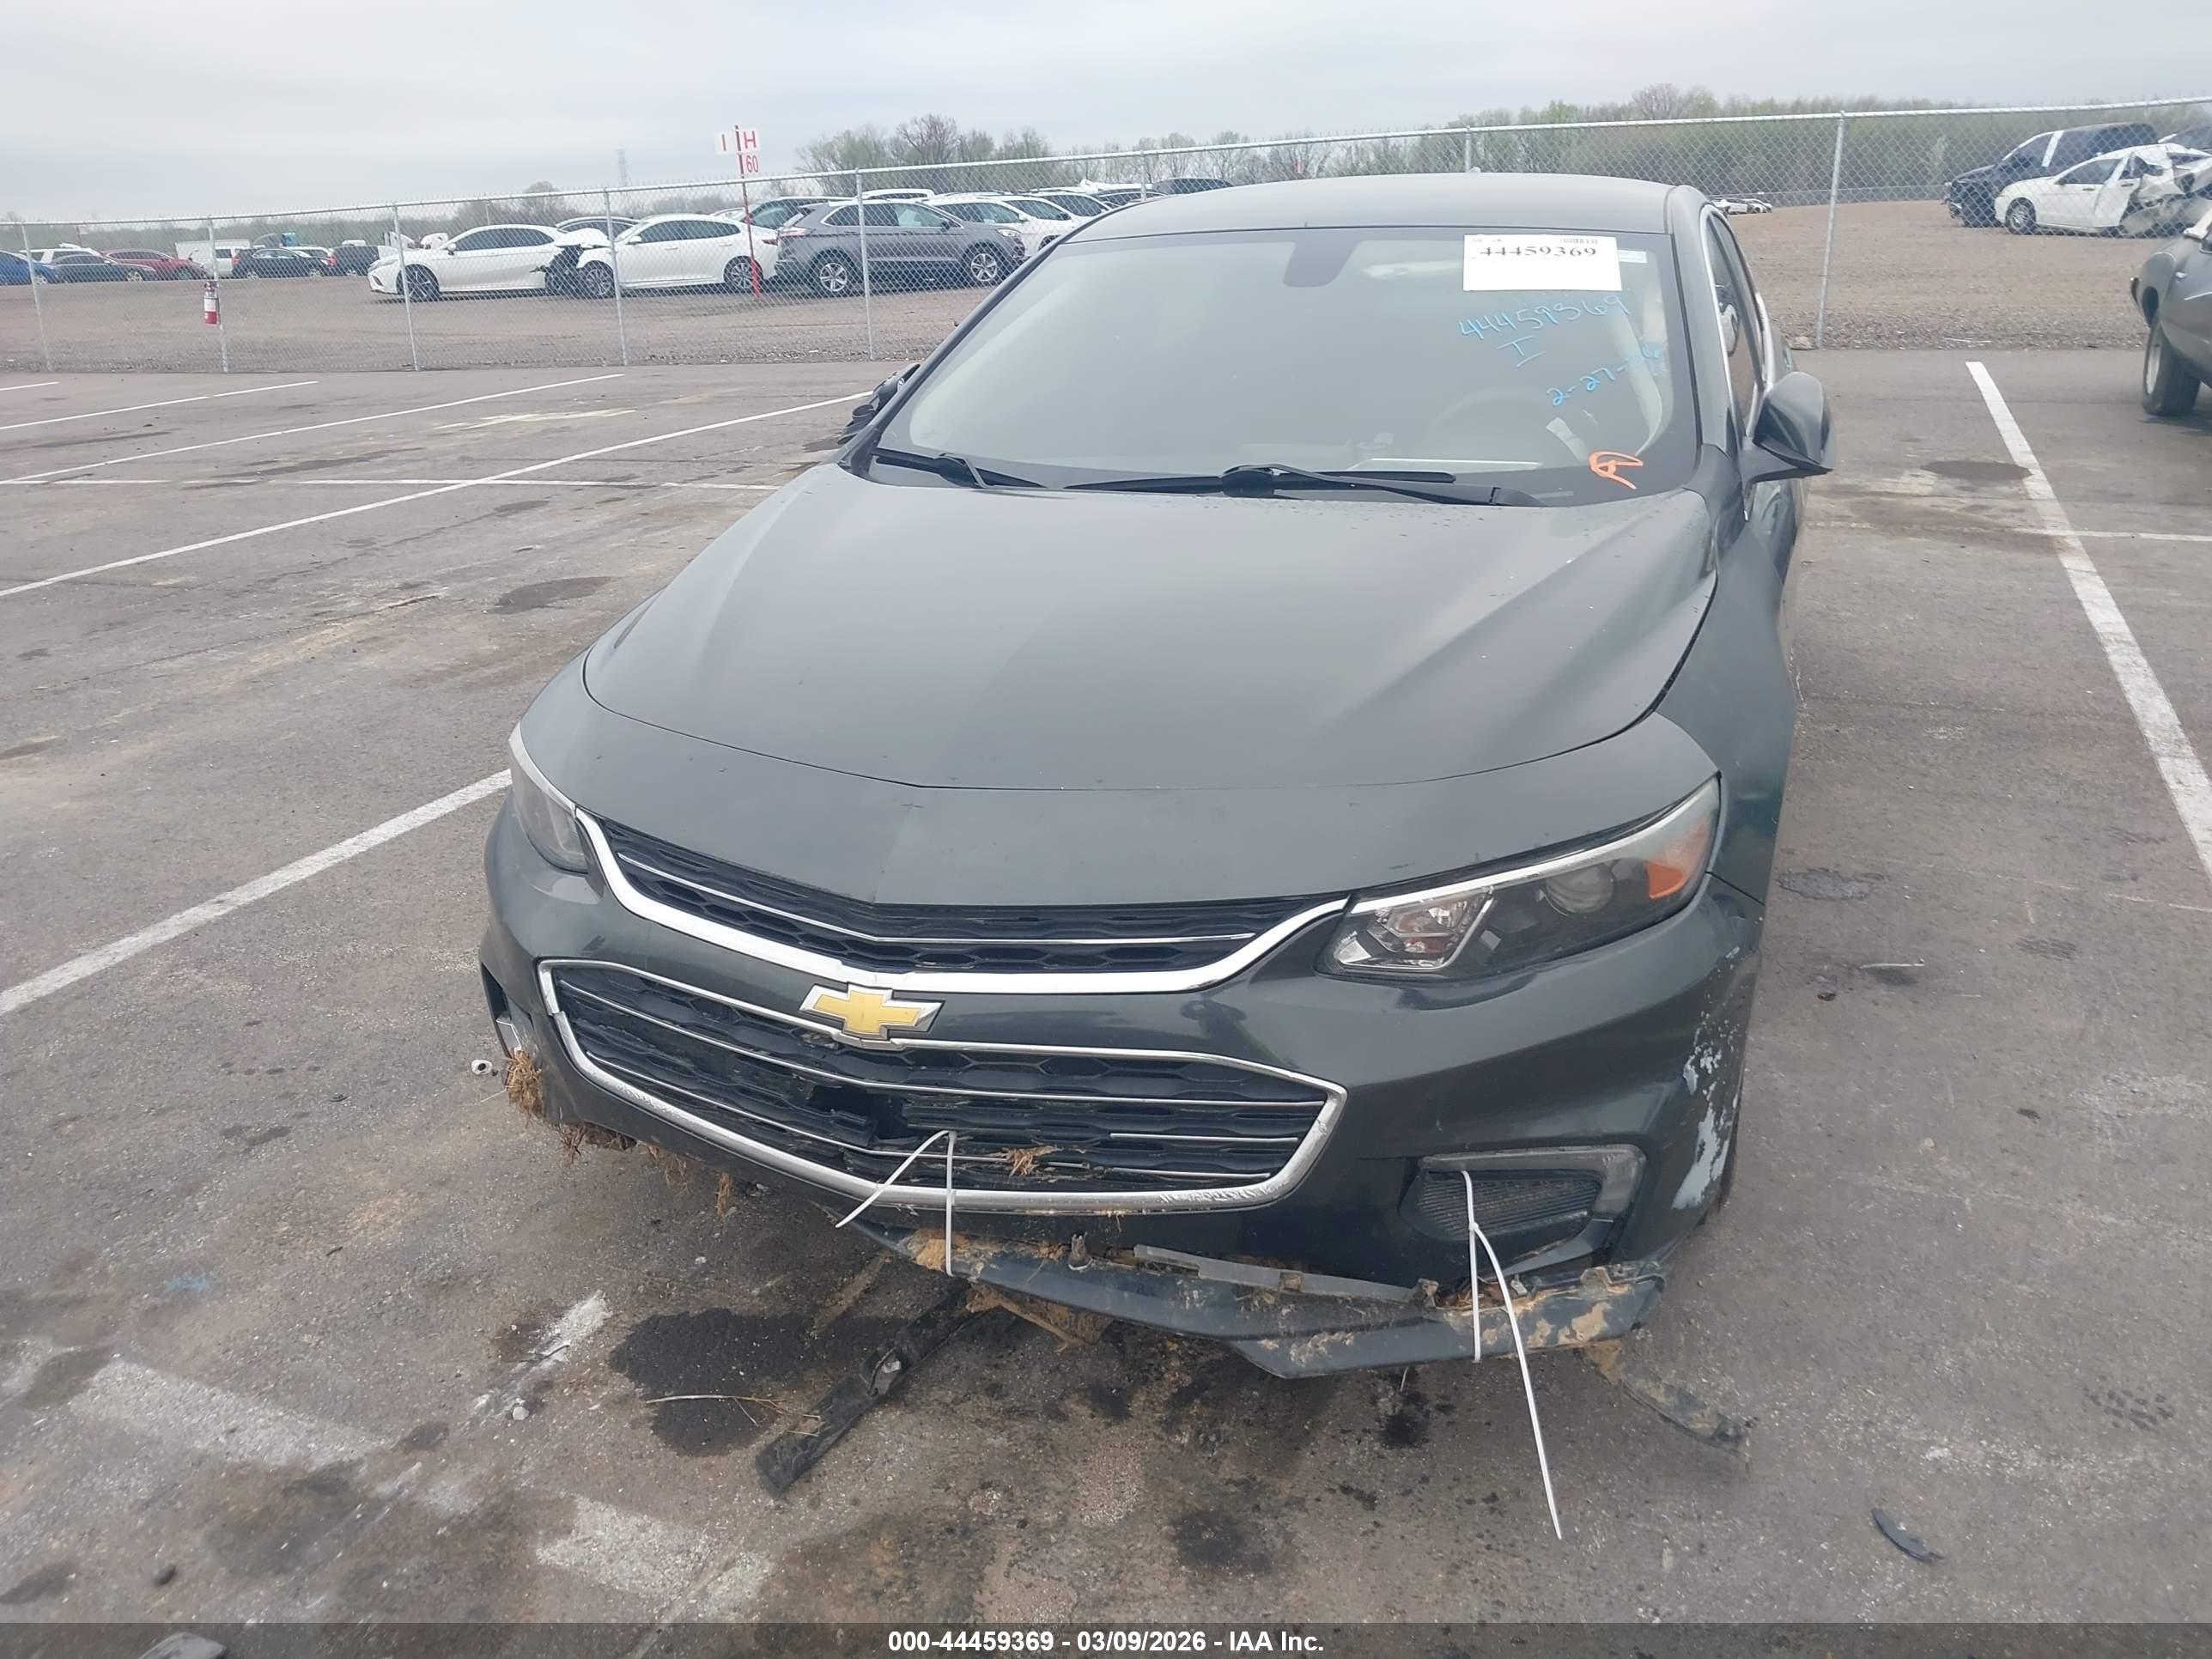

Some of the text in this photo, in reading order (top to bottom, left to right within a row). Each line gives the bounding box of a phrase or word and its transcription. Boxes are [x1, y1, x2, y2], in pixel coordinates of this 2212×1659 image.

[743, 130, 757, 149] H
[745, 155, 759, 173] 60
[1480, 246, 1597, 257] 44459369
[1459, 295, 1630, 340] 44459369
